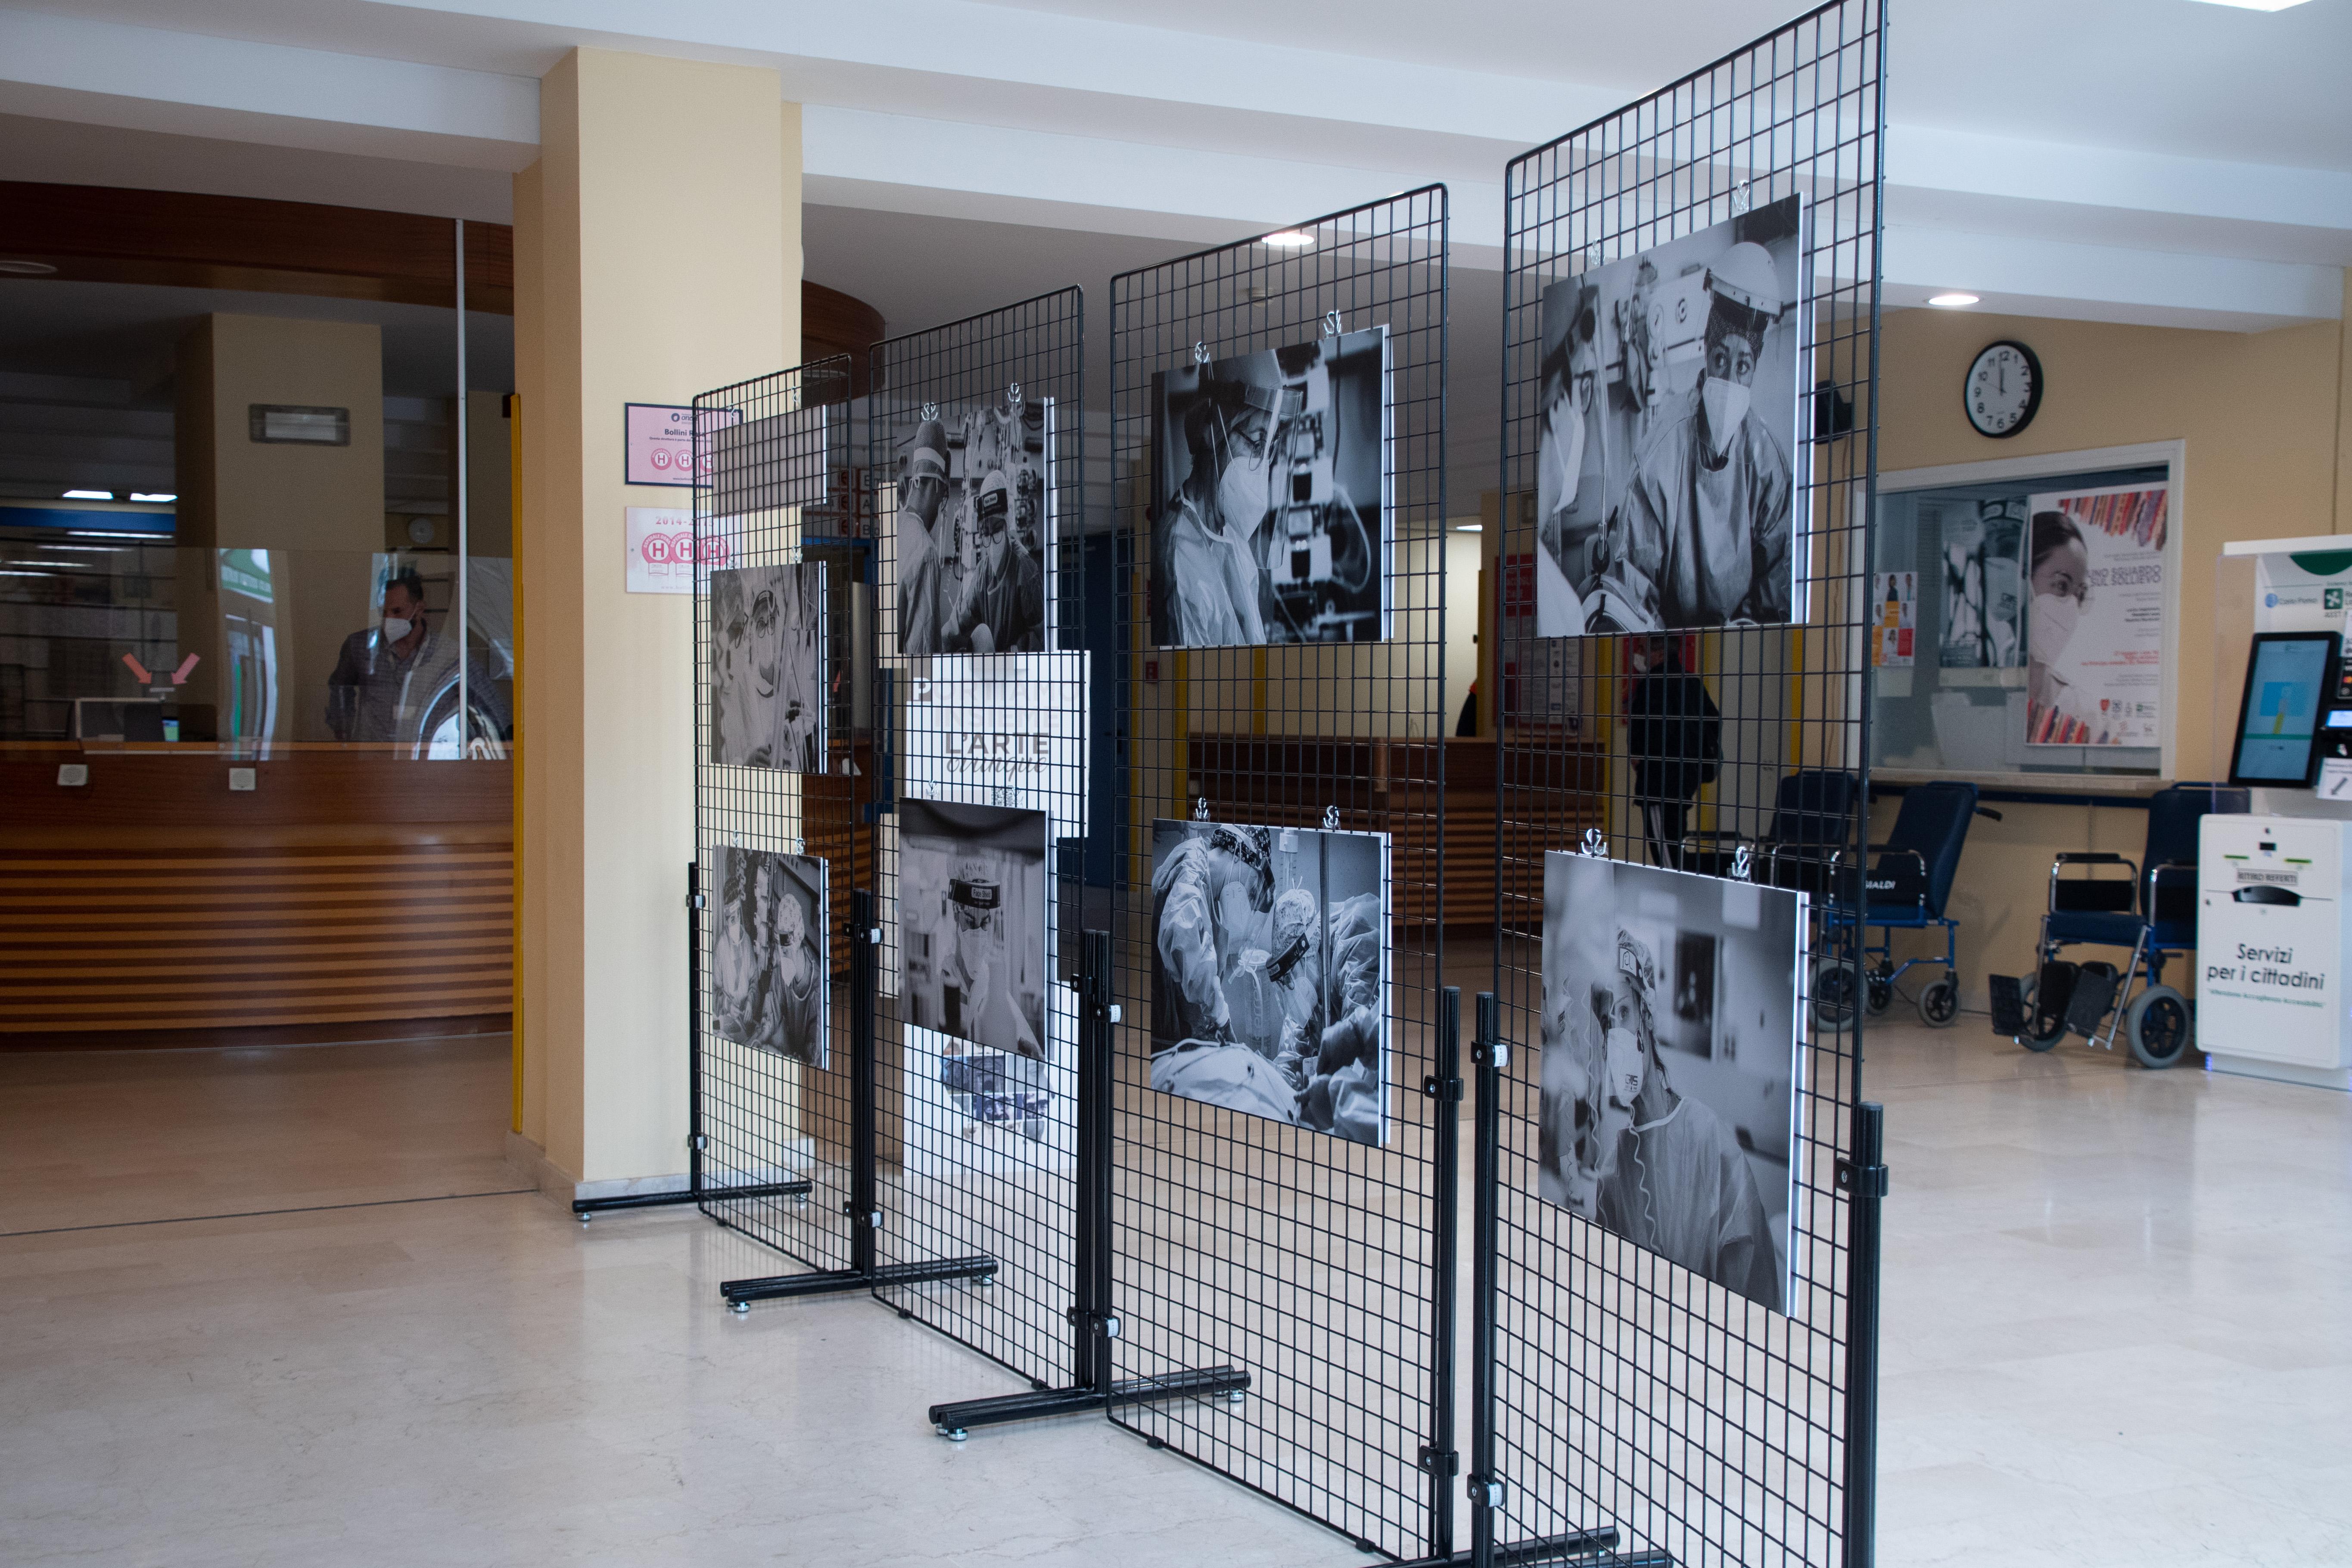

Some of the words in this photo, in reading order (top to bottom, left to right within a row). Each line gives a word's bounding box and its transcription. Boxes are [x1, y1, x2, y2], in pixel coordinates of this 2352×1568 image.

[1999, 350, 2010, 361] 12
[658, 454, 665, 464] H
[681, 456, 689, 465] H
[653, 543, 665, 558] H
[680, 542, 692, 558] H
[935, 706, 1060, 728] INSIEME
[946, 732, 1049, 754] L'ARTE
[946, 756, 1047, 782] ovunque
[2237, 943, 2293, 963] Servizi
[2207, 965, 2236, 981] per
[2241, 965, 2246, 980] i
[2251, 968, 2325, 989] cittadini
